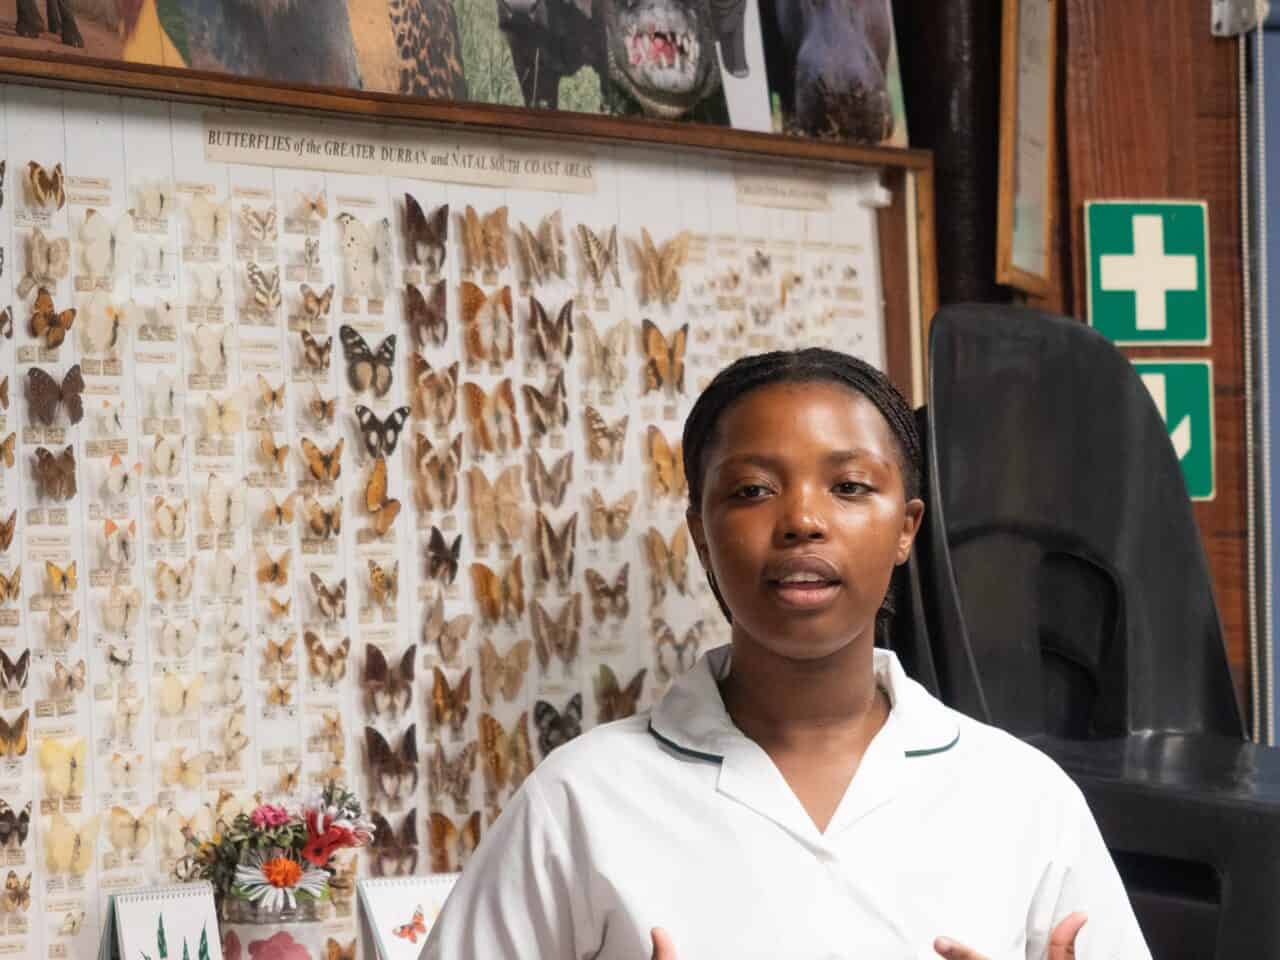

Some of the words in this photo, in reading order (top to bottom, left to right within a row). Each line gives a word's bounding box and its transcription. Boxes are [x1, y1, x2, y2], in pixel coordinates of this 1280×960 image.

[208, 129, 291, 152] BUTTERFLIES
[293, 136, 305, 156] of
[306, 141, 321, 155] the
[324, 140, 376, 161] GREATER
[381, 145, 427, 165] DURBAN
[431, 153, 449, 166] and
[450, 152, 488, 170] NATAL
[489, 157, 520, 174] SOUTH
[524, 160, 561, 177] COAST
